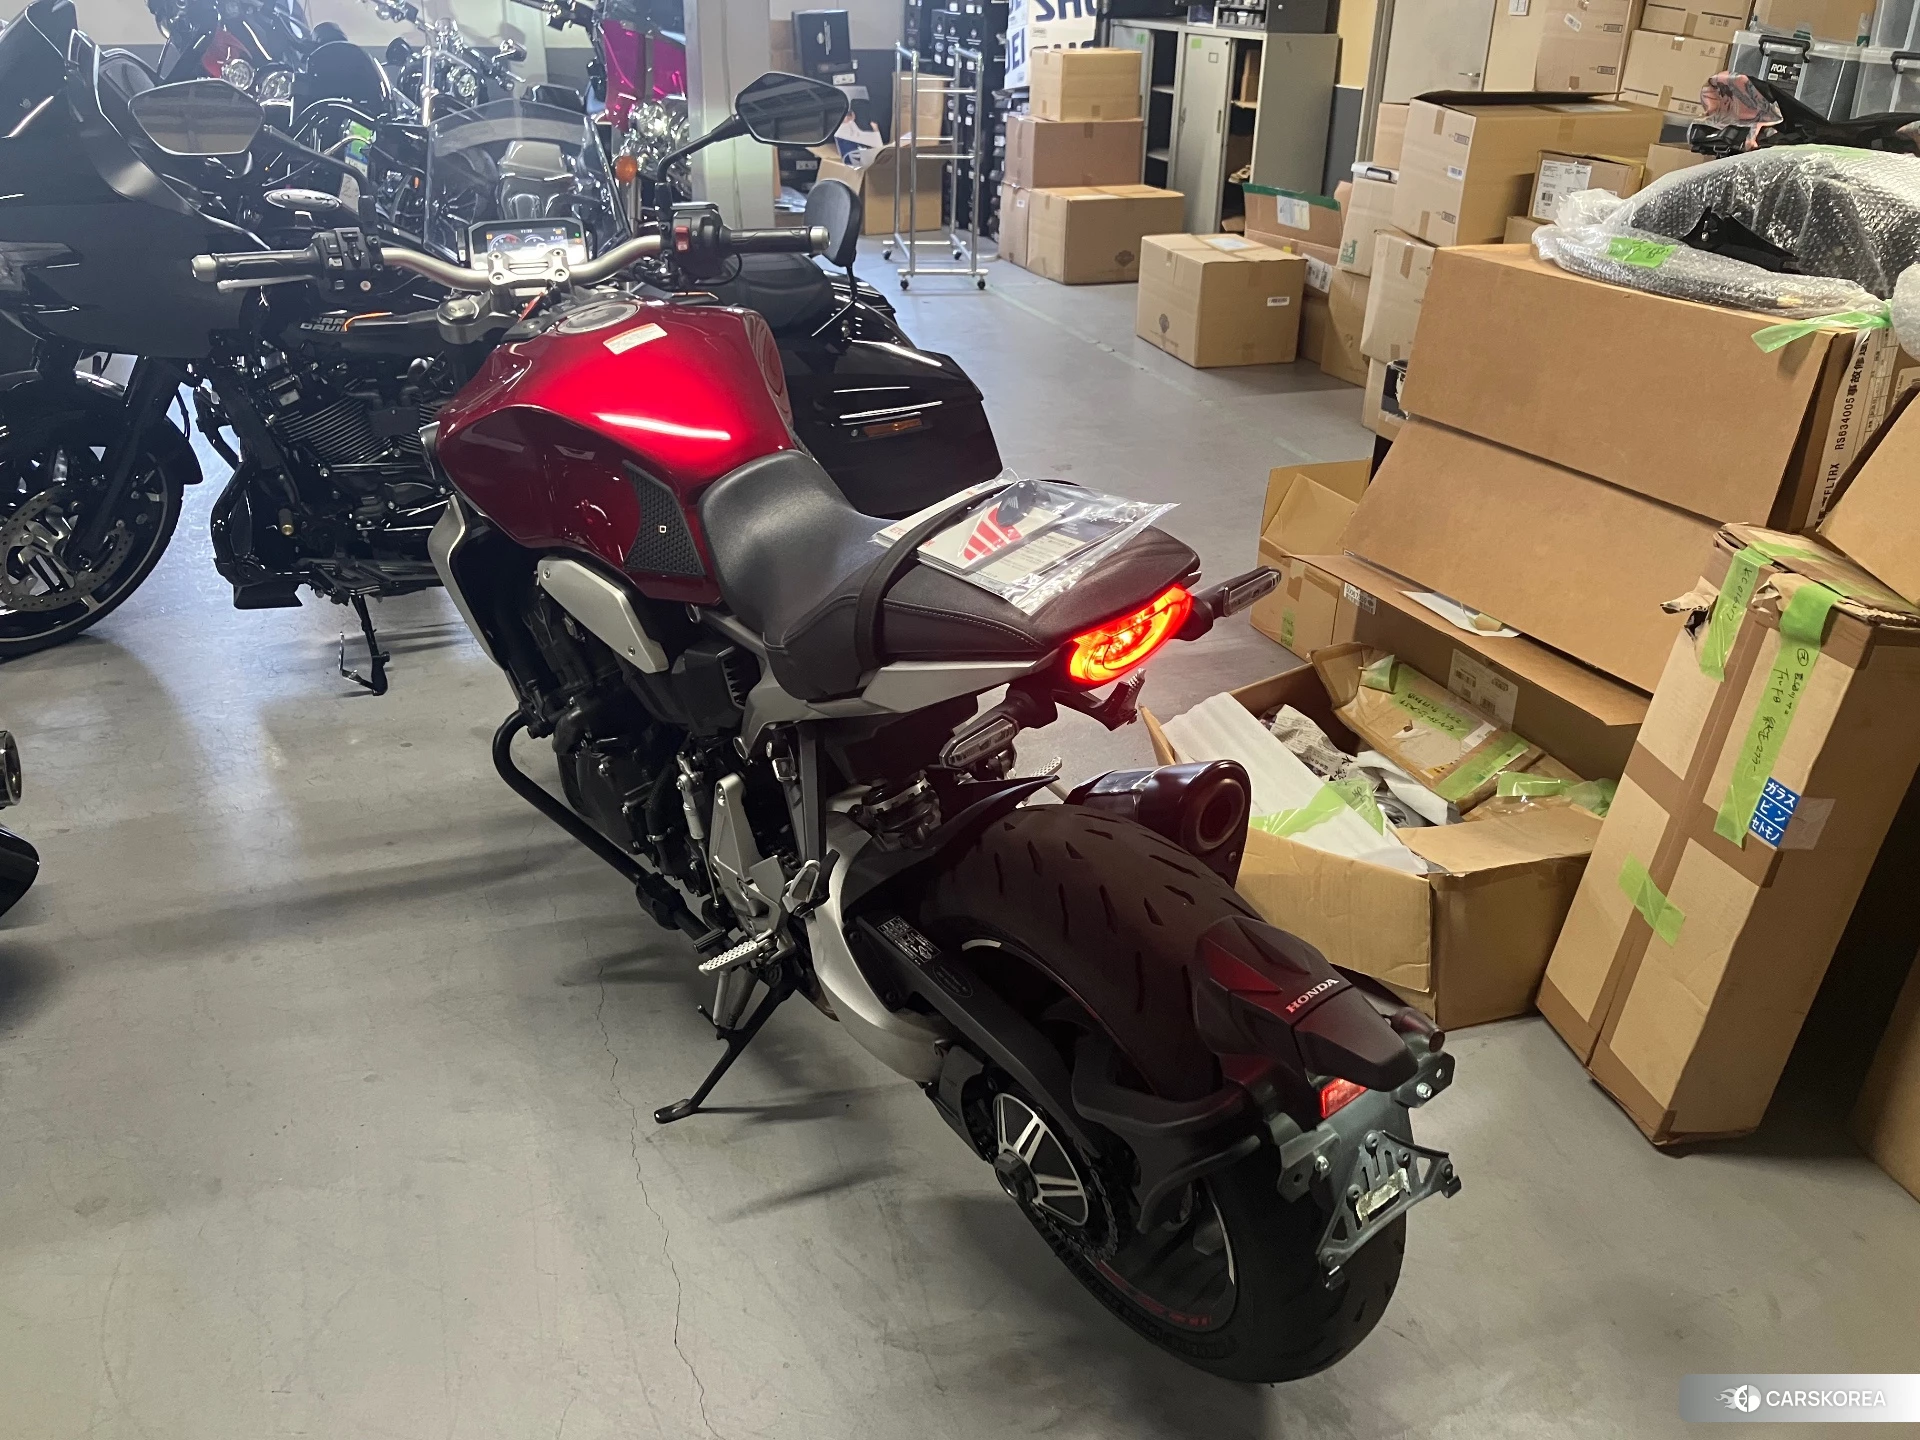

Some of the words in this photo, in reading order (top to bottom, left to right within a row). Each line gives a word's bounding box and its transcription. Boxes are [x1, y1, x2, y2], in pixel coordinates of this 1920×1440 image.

[1765, 782, 1796, 808] ガラス
[1760, 800, 1786, 821] ビン
[1752, 816, 1780, 841] セトモノ
[1285, 978, 1340, 1013] HONDA
